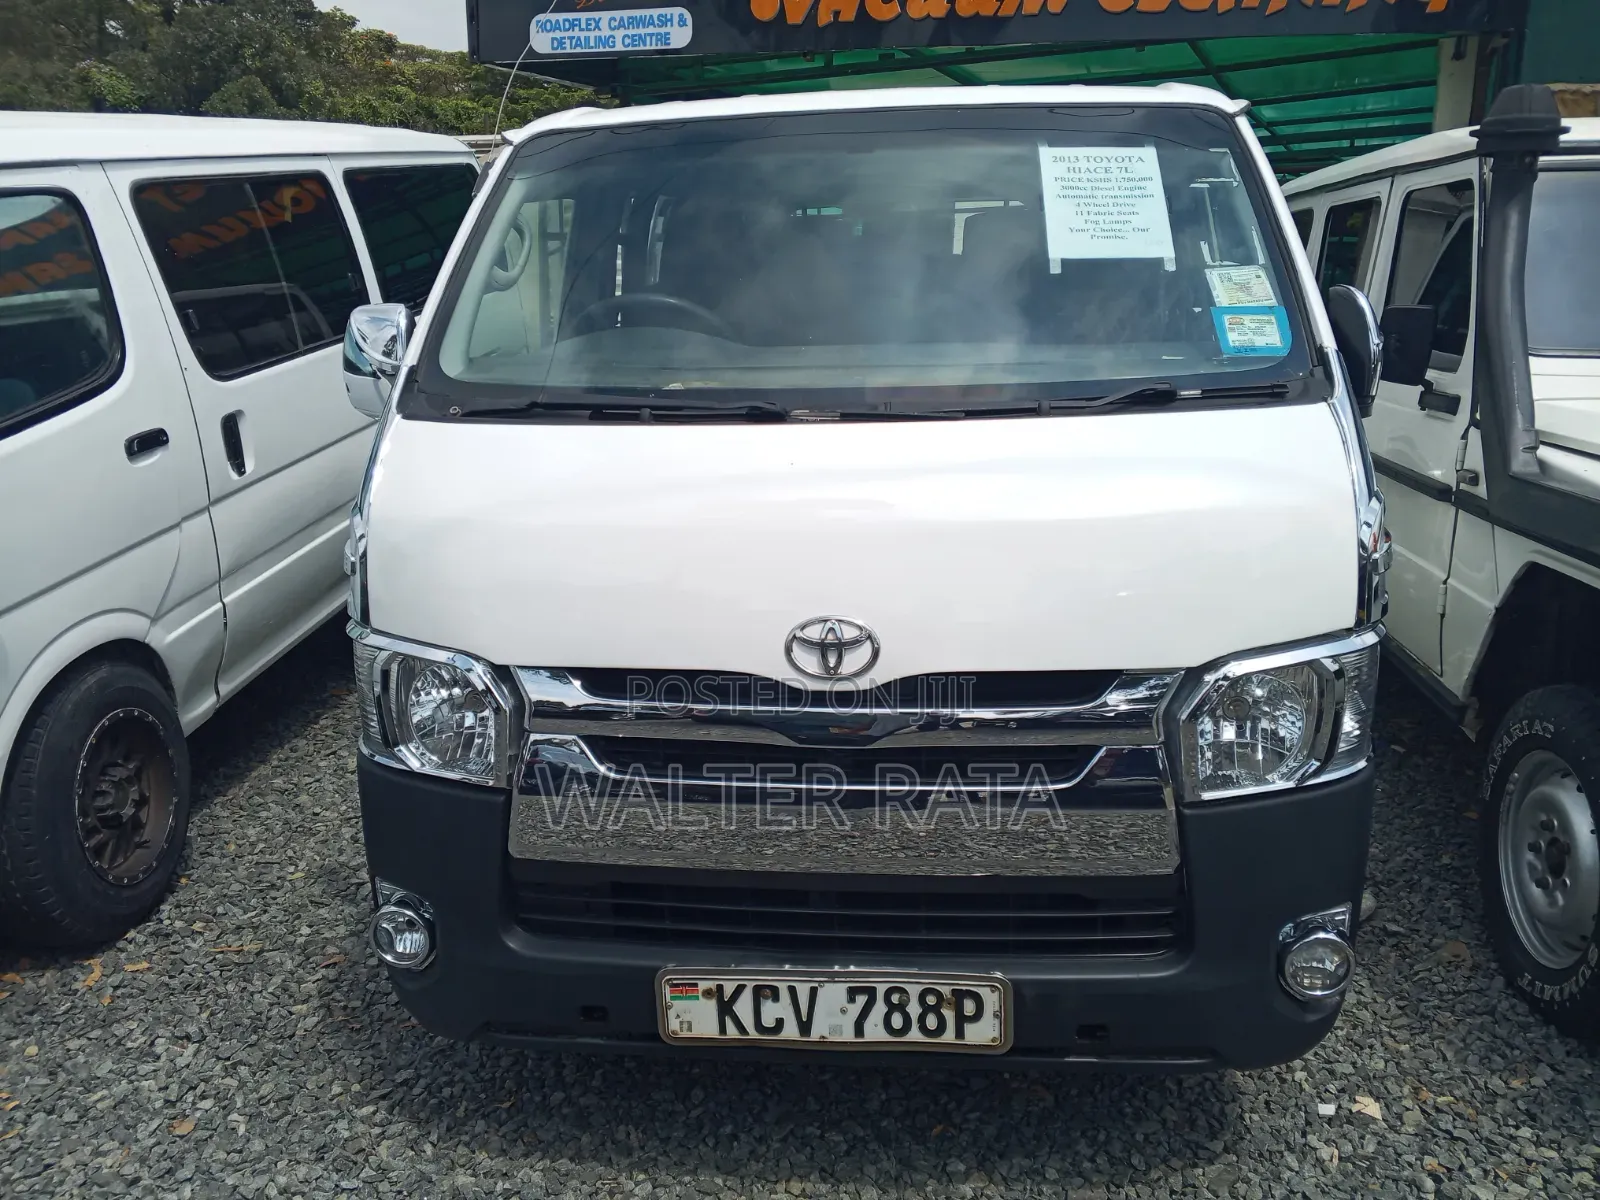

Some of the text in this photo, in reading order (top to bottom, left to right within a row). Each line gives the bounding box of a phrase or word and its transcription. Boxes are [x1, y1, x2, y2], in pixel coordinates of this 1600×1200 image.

[535, 12, 689, 34] ROADFLEX CARWASH &
[550, 31, 672, 51] DETAILING CENTRE
[1051, 155, 1146, 164] 2013 TOYOTA
[1067, 166, 1134, 174] HIACE 7L
[1117, 184, 1148, 192] Engine
[714, 982, 820, 1038] KCV
[846, 985, 985, 1040] 788P
